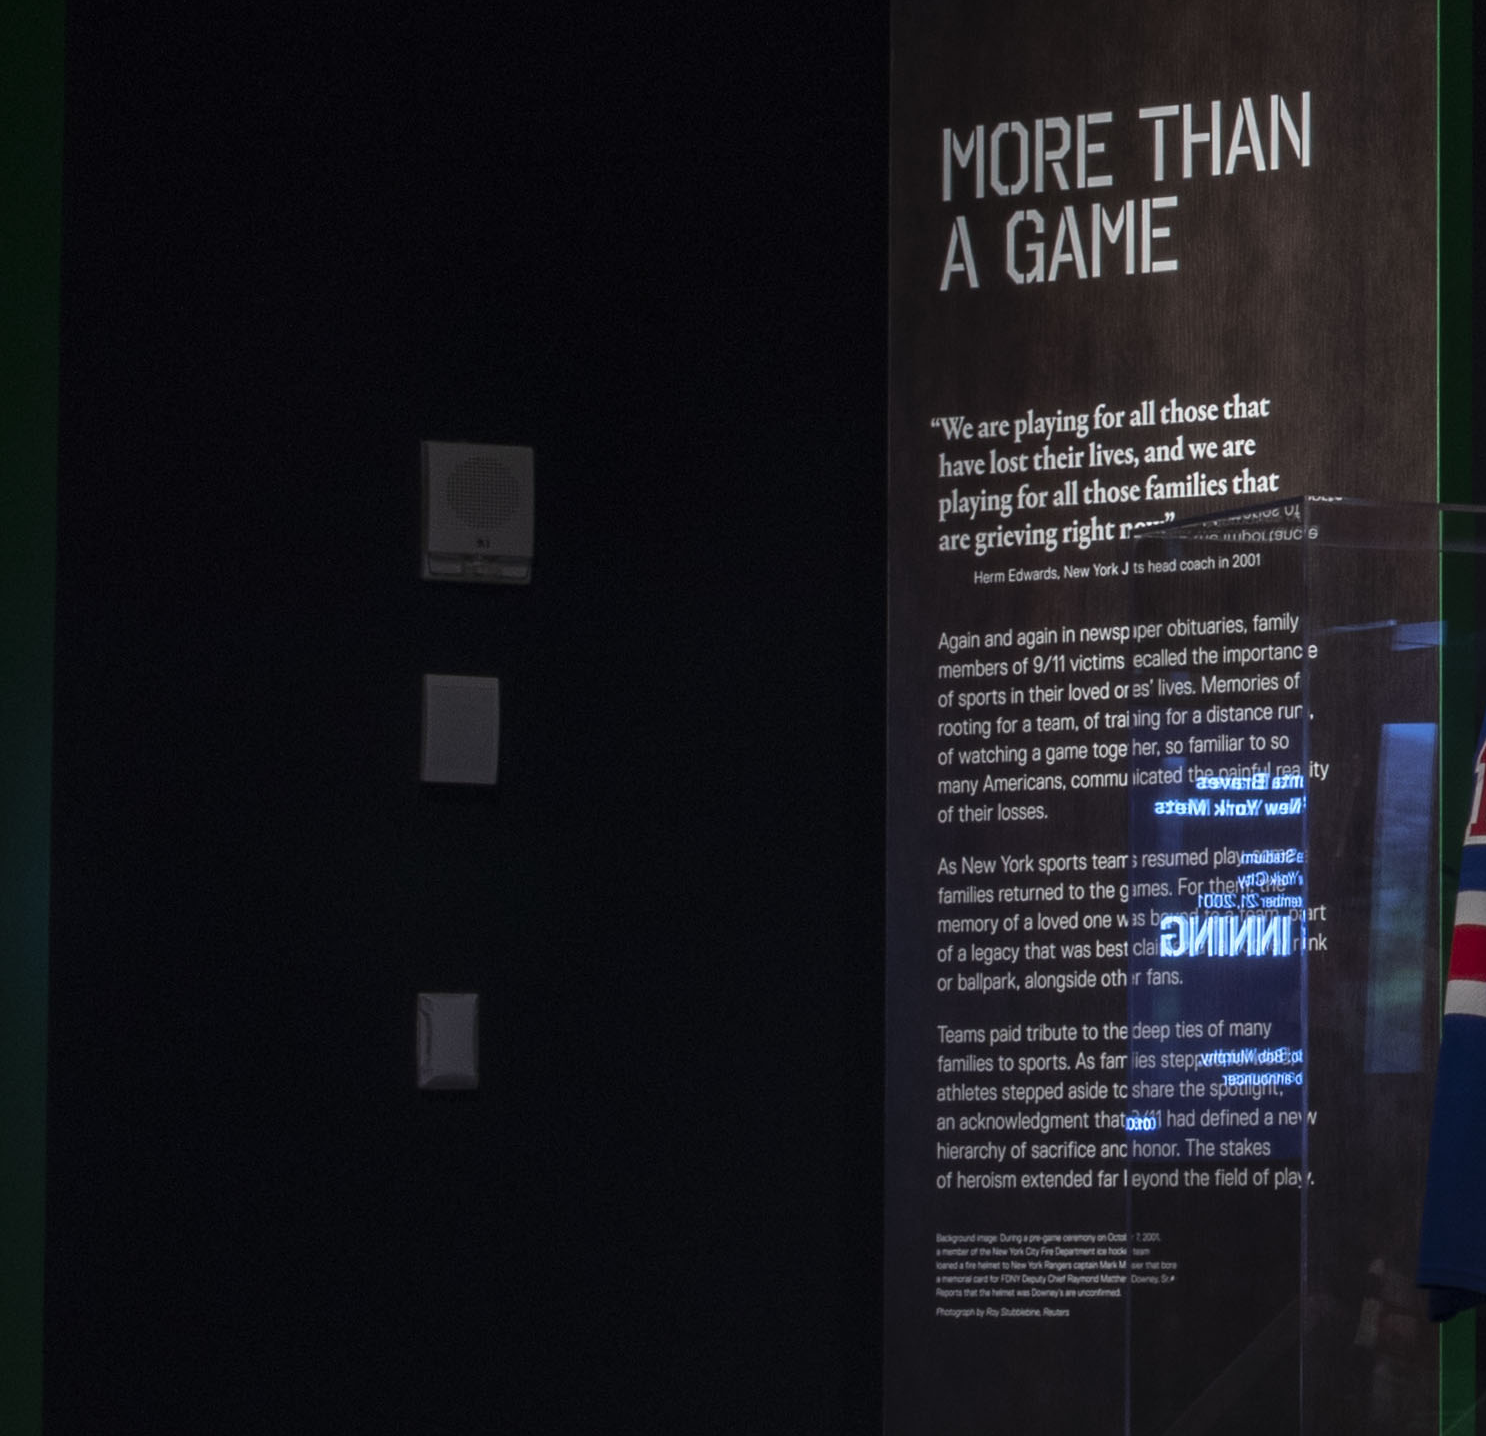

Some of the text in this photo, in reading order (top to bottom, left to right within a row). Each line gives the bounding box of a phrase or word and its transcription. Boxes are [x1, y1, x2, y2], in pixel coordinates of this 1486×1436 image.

[942, 91, 1310, 202] MORE THAN
[939, 196, 1178, 291] A GAME
[978, 420, 1009, 438] are
[1015, 410, 1089, 443] playing
[1094, 404, 1125, 429] for
[1130, 400, 1155, 426] all
[1160, 398, 1218, 424] those
[1223, 394, 1270, 419] that
[939, 436, 1255, 477] have lost their lives, and we are
[939, 469, 1279, 522] playing for all those families that
[939, 534, 970, 551] are
[975, 523, 1057, 556] grieving
[1063, 517, 1115, 549] right
[974, 553, 1260, 583] Herm Edwards, New York Jts head coach in 2001
[939, 632, 980, 653] Again
[985, 629, 1012, 647] and
[1017, 628, 1057, 649] again
[1063, 626, 1075, 642] in
[1167, 617, 1247, 636] obituaries,
[1253, 613, 1299, 633] family
[939, 660, 1008, 678] members
[1013, 657, 1028, 675] of
[1033, 655, 1064, 673] 9/11
[1070, 654, 1124, 671] victims
[1133, 648, 1187, 668] ecalled
[1192, 647, 1218, 664] the
[938, 672, 1300, 710] of sports in their loved lives. Memories of
[938, 746, 1088, 766] of watching a game
[938, 804, 1048, 823] of their losses.
[938, 882, 1115, 904] families returned to the
[937, 968, 1183, 994] or ballpark, alongside fans.
[938, 1020, 1272, 1046] Teams paid tribute to the deep ties of many
[937, 1081, 1108, 1104] athletes stepped aside
[937, 1138, 1271, 1162] hierarchy of sacrifice honor. The stakes
[937, 1172, 952, 1188] of
[958, 1171, 1016, 1188] heroism
[1021, 1170, 1092, 1188] extended
[1098, 1170, 1119, 1187] far
[1184, 1169, 1209, 1186] the
[1215, 1168, 1247, 1186] field
[1253, 1168, 1269, 1185] of
